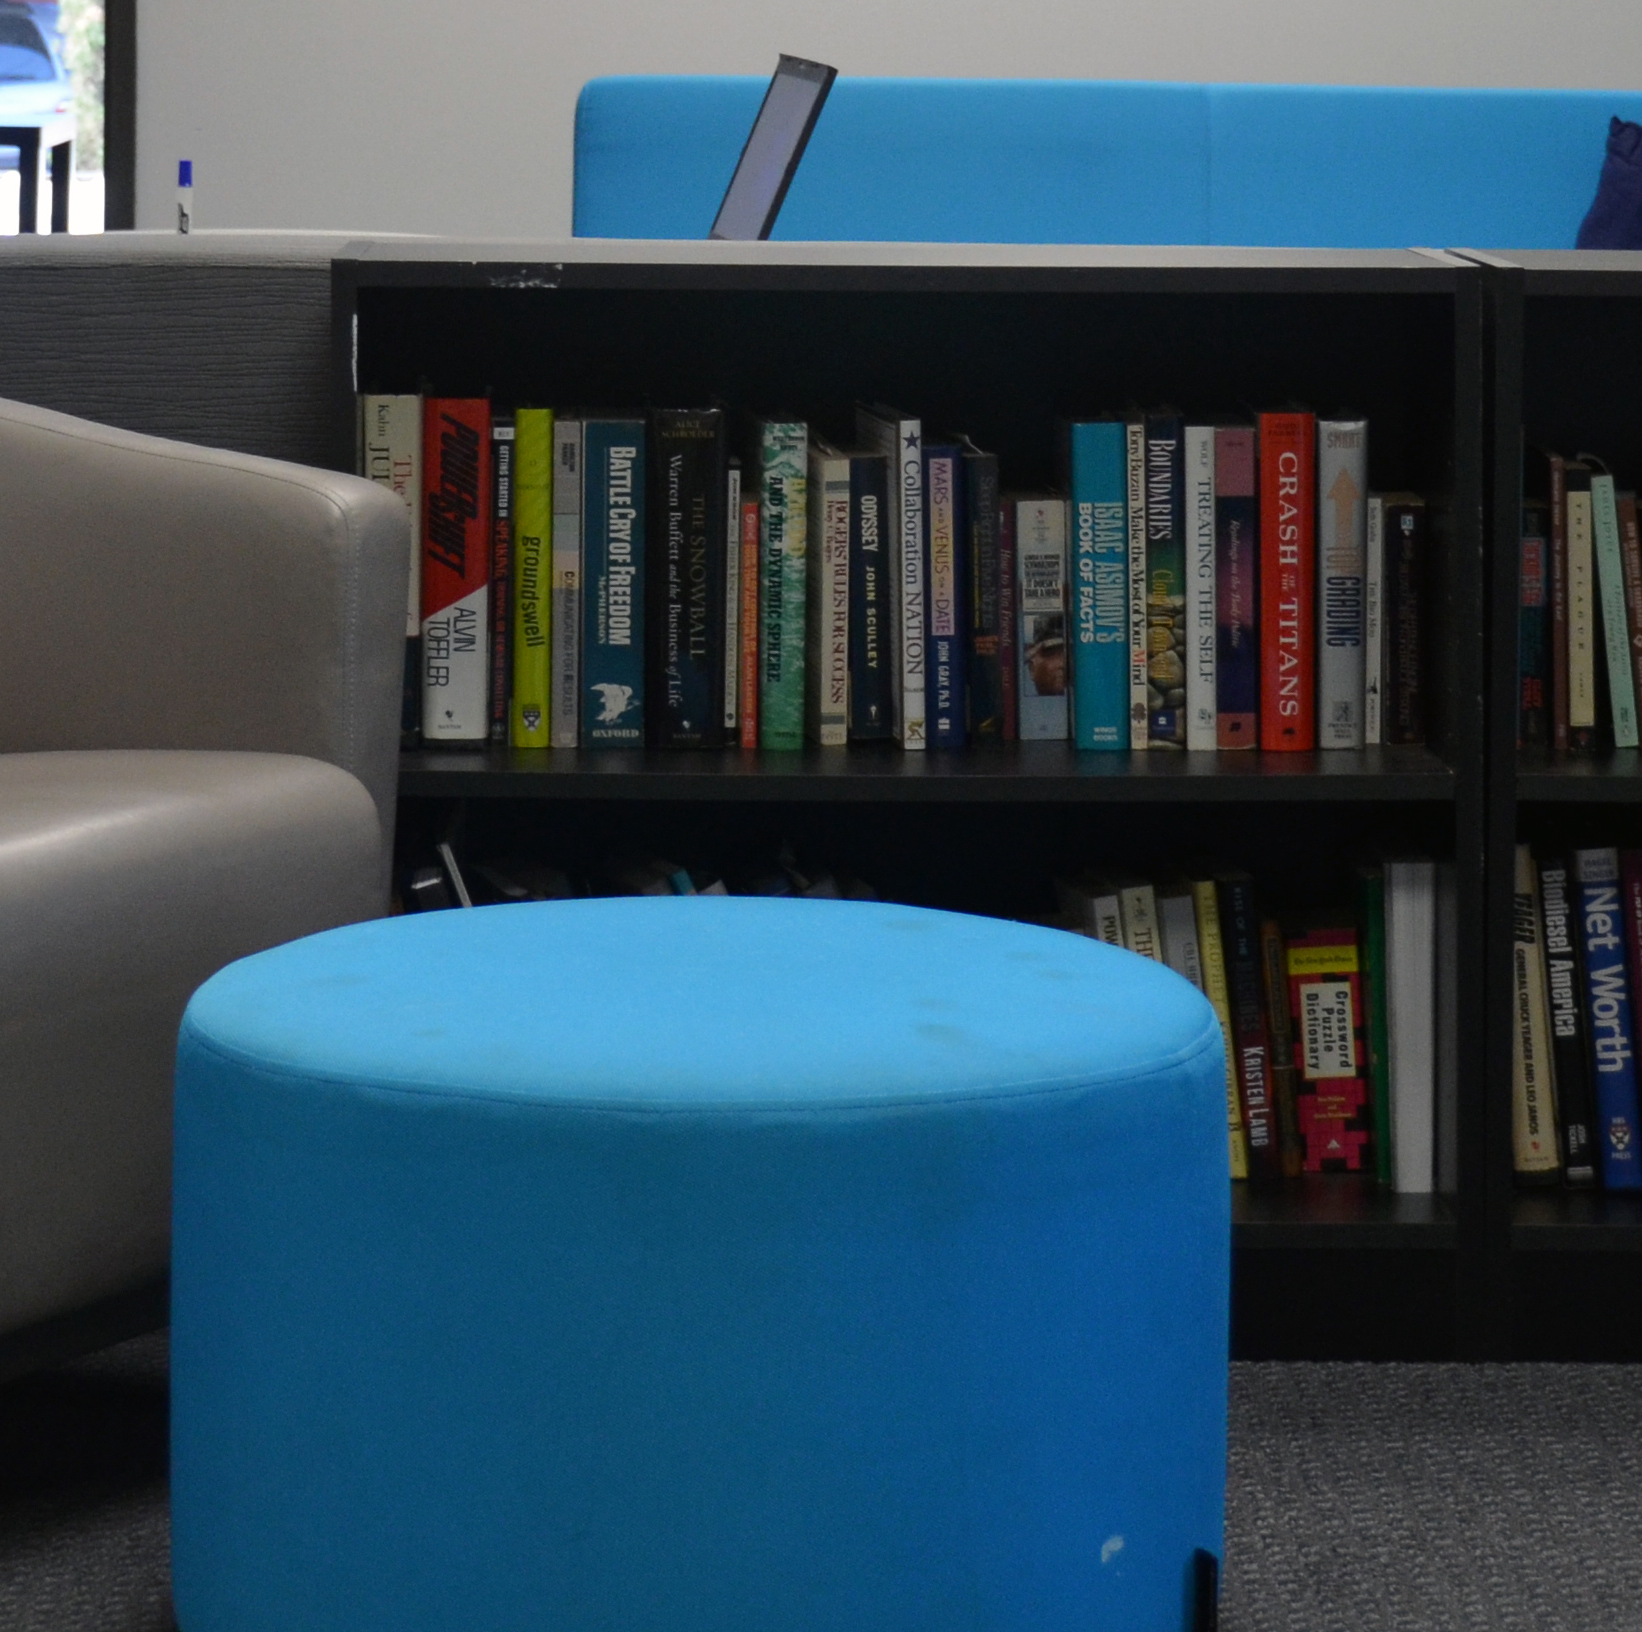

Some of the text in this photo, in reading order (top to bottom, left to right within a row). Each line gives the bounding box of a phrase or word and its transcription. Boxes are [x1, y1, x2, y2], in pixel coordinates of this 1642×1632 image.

[378, 405, 389, 436] Kahn
[394, 455, 412, 495] The
[499, 445, 509, 517] GETTING STARTED IN
[934, 461, 949, 505] MARS
[1148, 439, 1177, 539] BOUNDARIES
[1278, 452, 1298, 565] CRASH
[520, 536, 545, 647] groundswell
[609, 447, 636, 645] BATTLE CRY OF FREEDOM
[666, 454, 682, 708] Warren Buffett and the Business of Life
[689, 494, 706, 661] THE SNOWBALL
[767, 476, 782, 682] AND THE DYNAMIC SPHERE
[860, 495, 878, 668] ODYSSEY JOHN SCULLEY
[904, 460, 923, 675] Collaboration NATION
[935, 525, 950, 574] VENUS
[1000, 549, 1011, 647] How to Win Friends
[1078, 503, 1095, 643] BOOK OF FACTS
[1093, 502, 1125, 643] ISAAC ASIMOV'S
[1130, 427, 1145, 685] Tony Buzan Make the Most of Your Mind
[1198, 477, 1214, 684] TREATING THE SELF
[1289, 575, 1296, 588] OF
[427, 617, 449, 686] TOFFLER
[453, 607, 477, 652] ALVIN
[563, 571, 575, 715] COMMUNICATING FOR RESULTS
[831, 563, 847, 704] RULES FOR SUCCESS
[936, 599, 951, 632] DATE
[937, 641, 950, 662] JOHN
[1279, 597, 1298, 716] TITANS
[592, 729, 639, 738] OXFORD
[1540, 869, 1578, 1037] Biodiesel America
[1583, 887, 1632, 1072] Net Worth
[1243, 1046, 1267, 1105] KRISTEN
[1305, 992, 1320, 1070] Dictionary
[1322, 1007, 1336, 1053] Puzzle
[1335, 991, 1352, 1068] Crossword
[1515, 949, 1540, 1135] GENERAL CHUCK YEAGER AND LEO JANOS
[1249, 1108, 1270, 1147] LAMB
